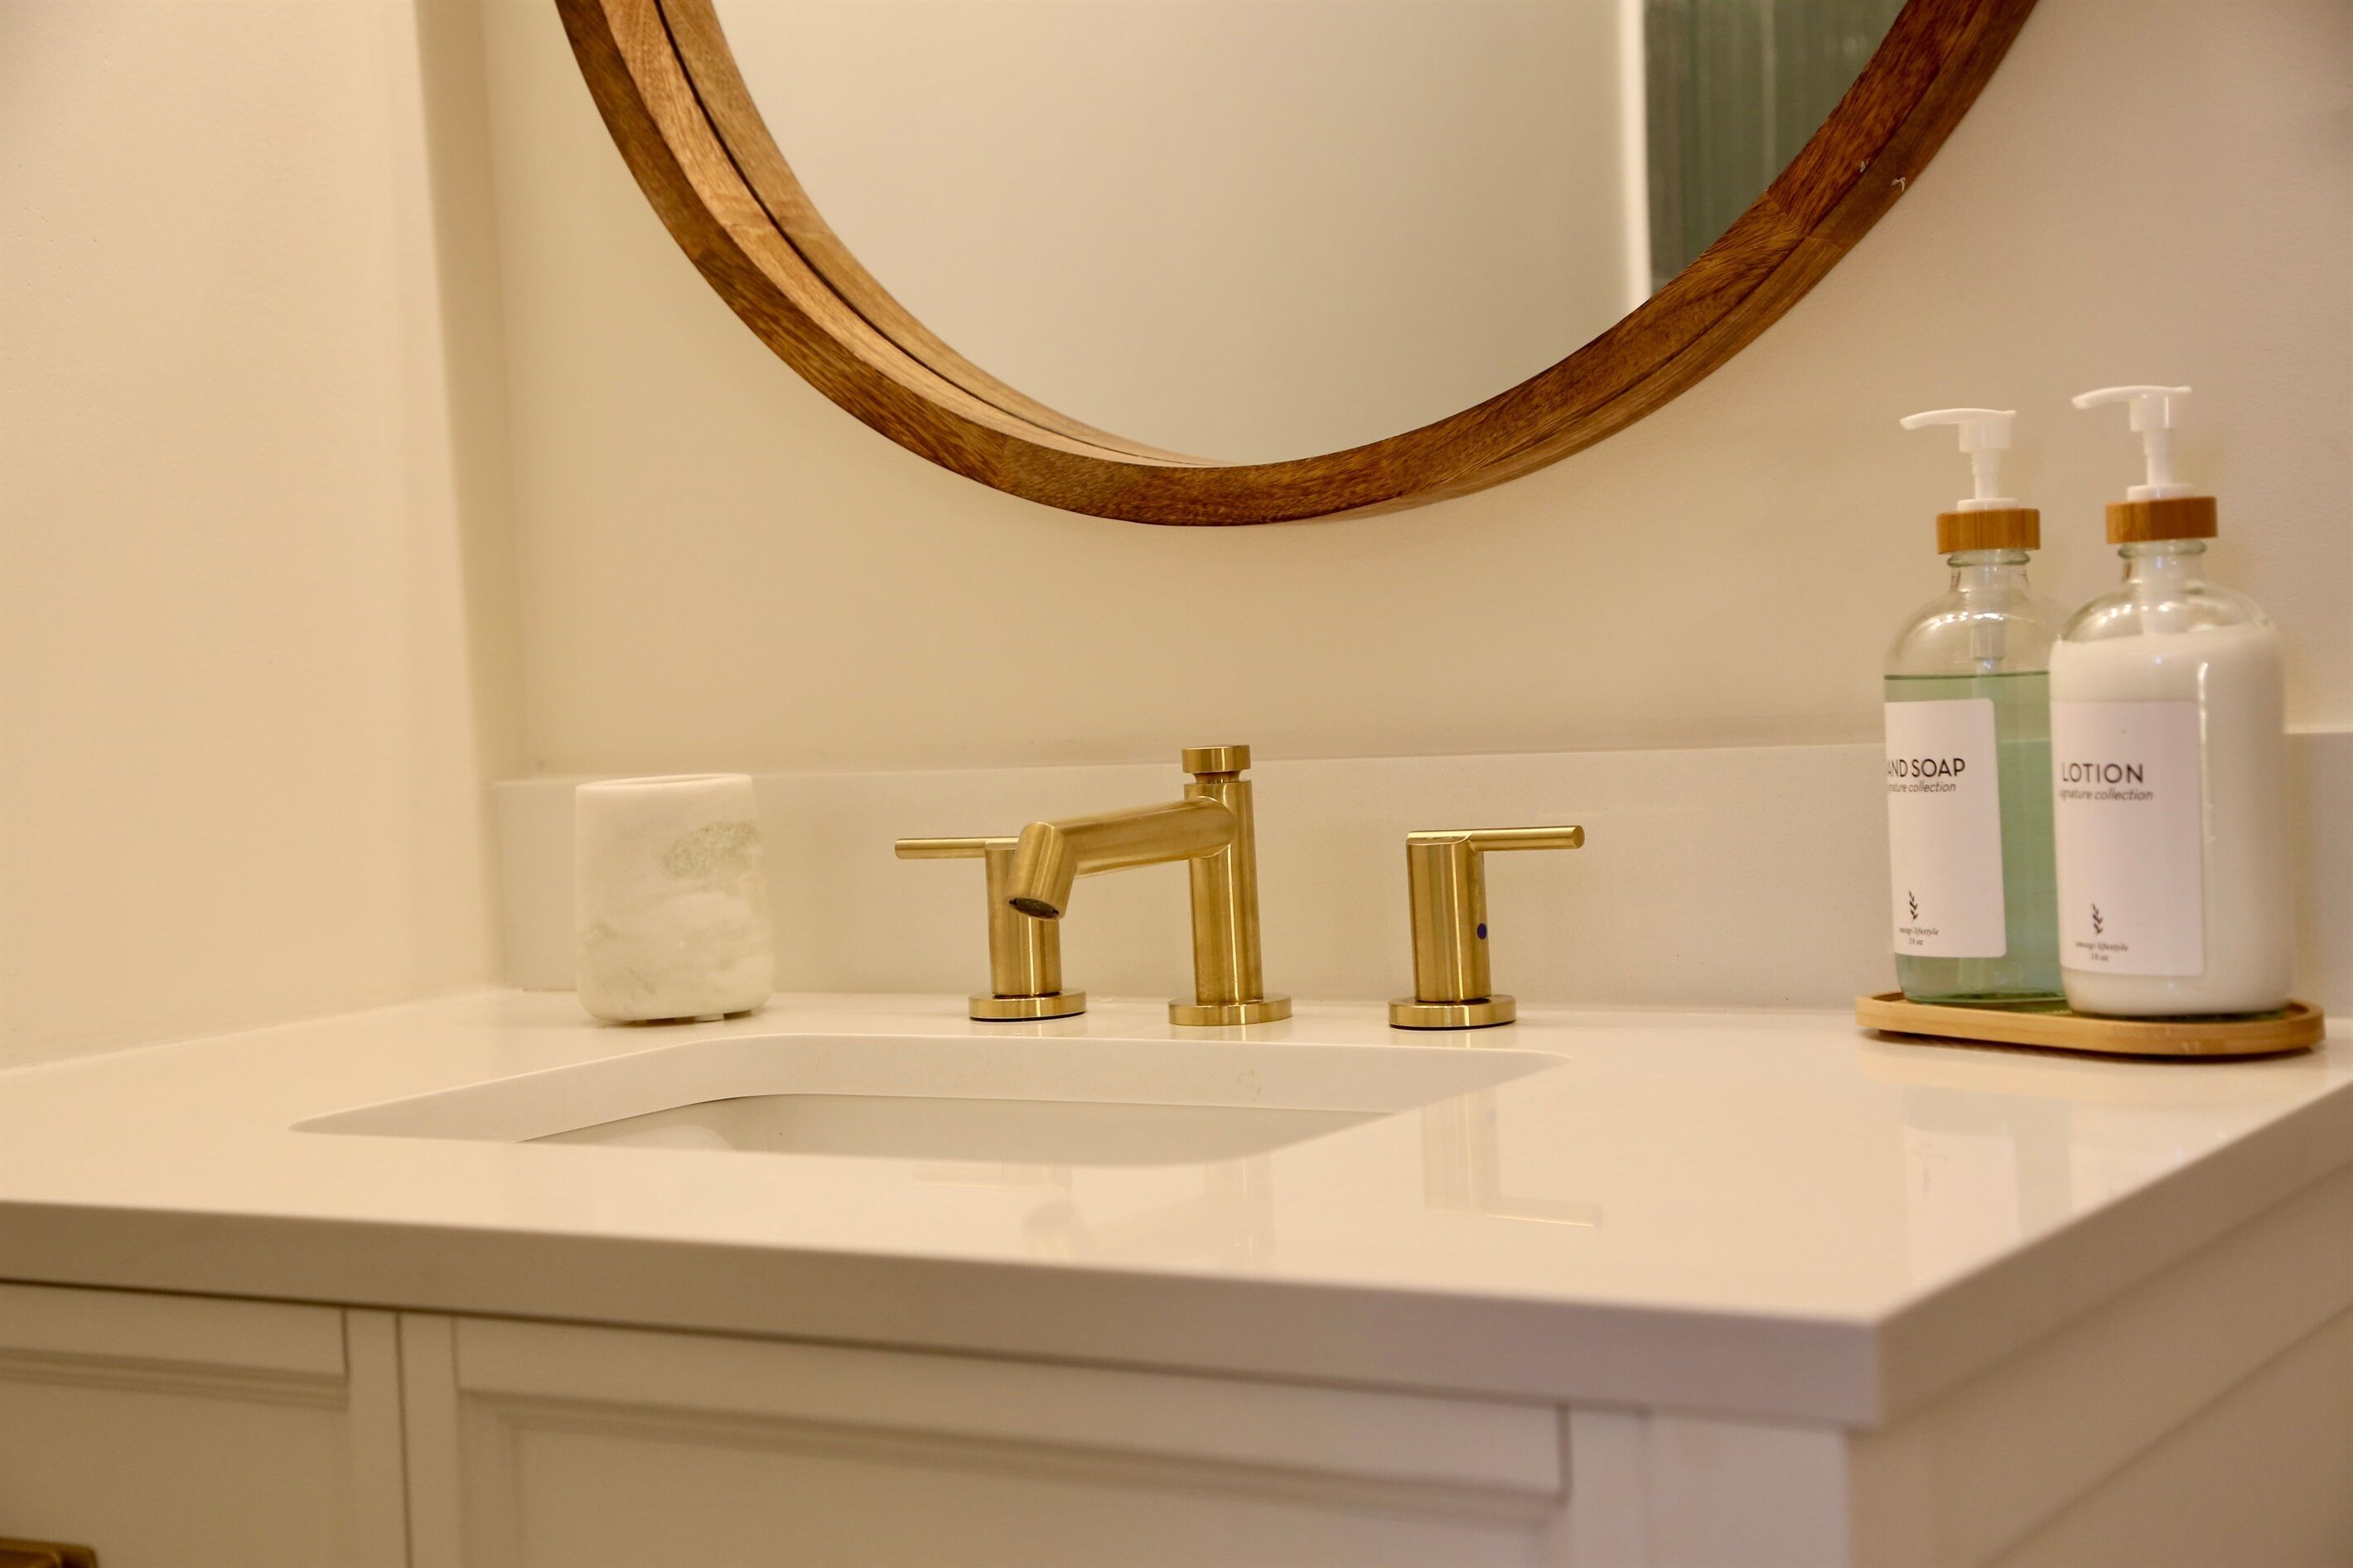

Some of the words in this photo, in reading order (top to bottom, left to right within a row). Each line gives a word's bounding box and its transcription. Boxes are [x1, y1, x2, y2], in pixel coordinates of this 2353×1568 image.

[1888, 759, 1908, 778] AND
[1911, 757, 1966, 778] SOAP
[2061, 762, 2144, 784] LOTION
[1908, 780, 1957, 793] collection
[2094, 787, 2154, 801] collection
